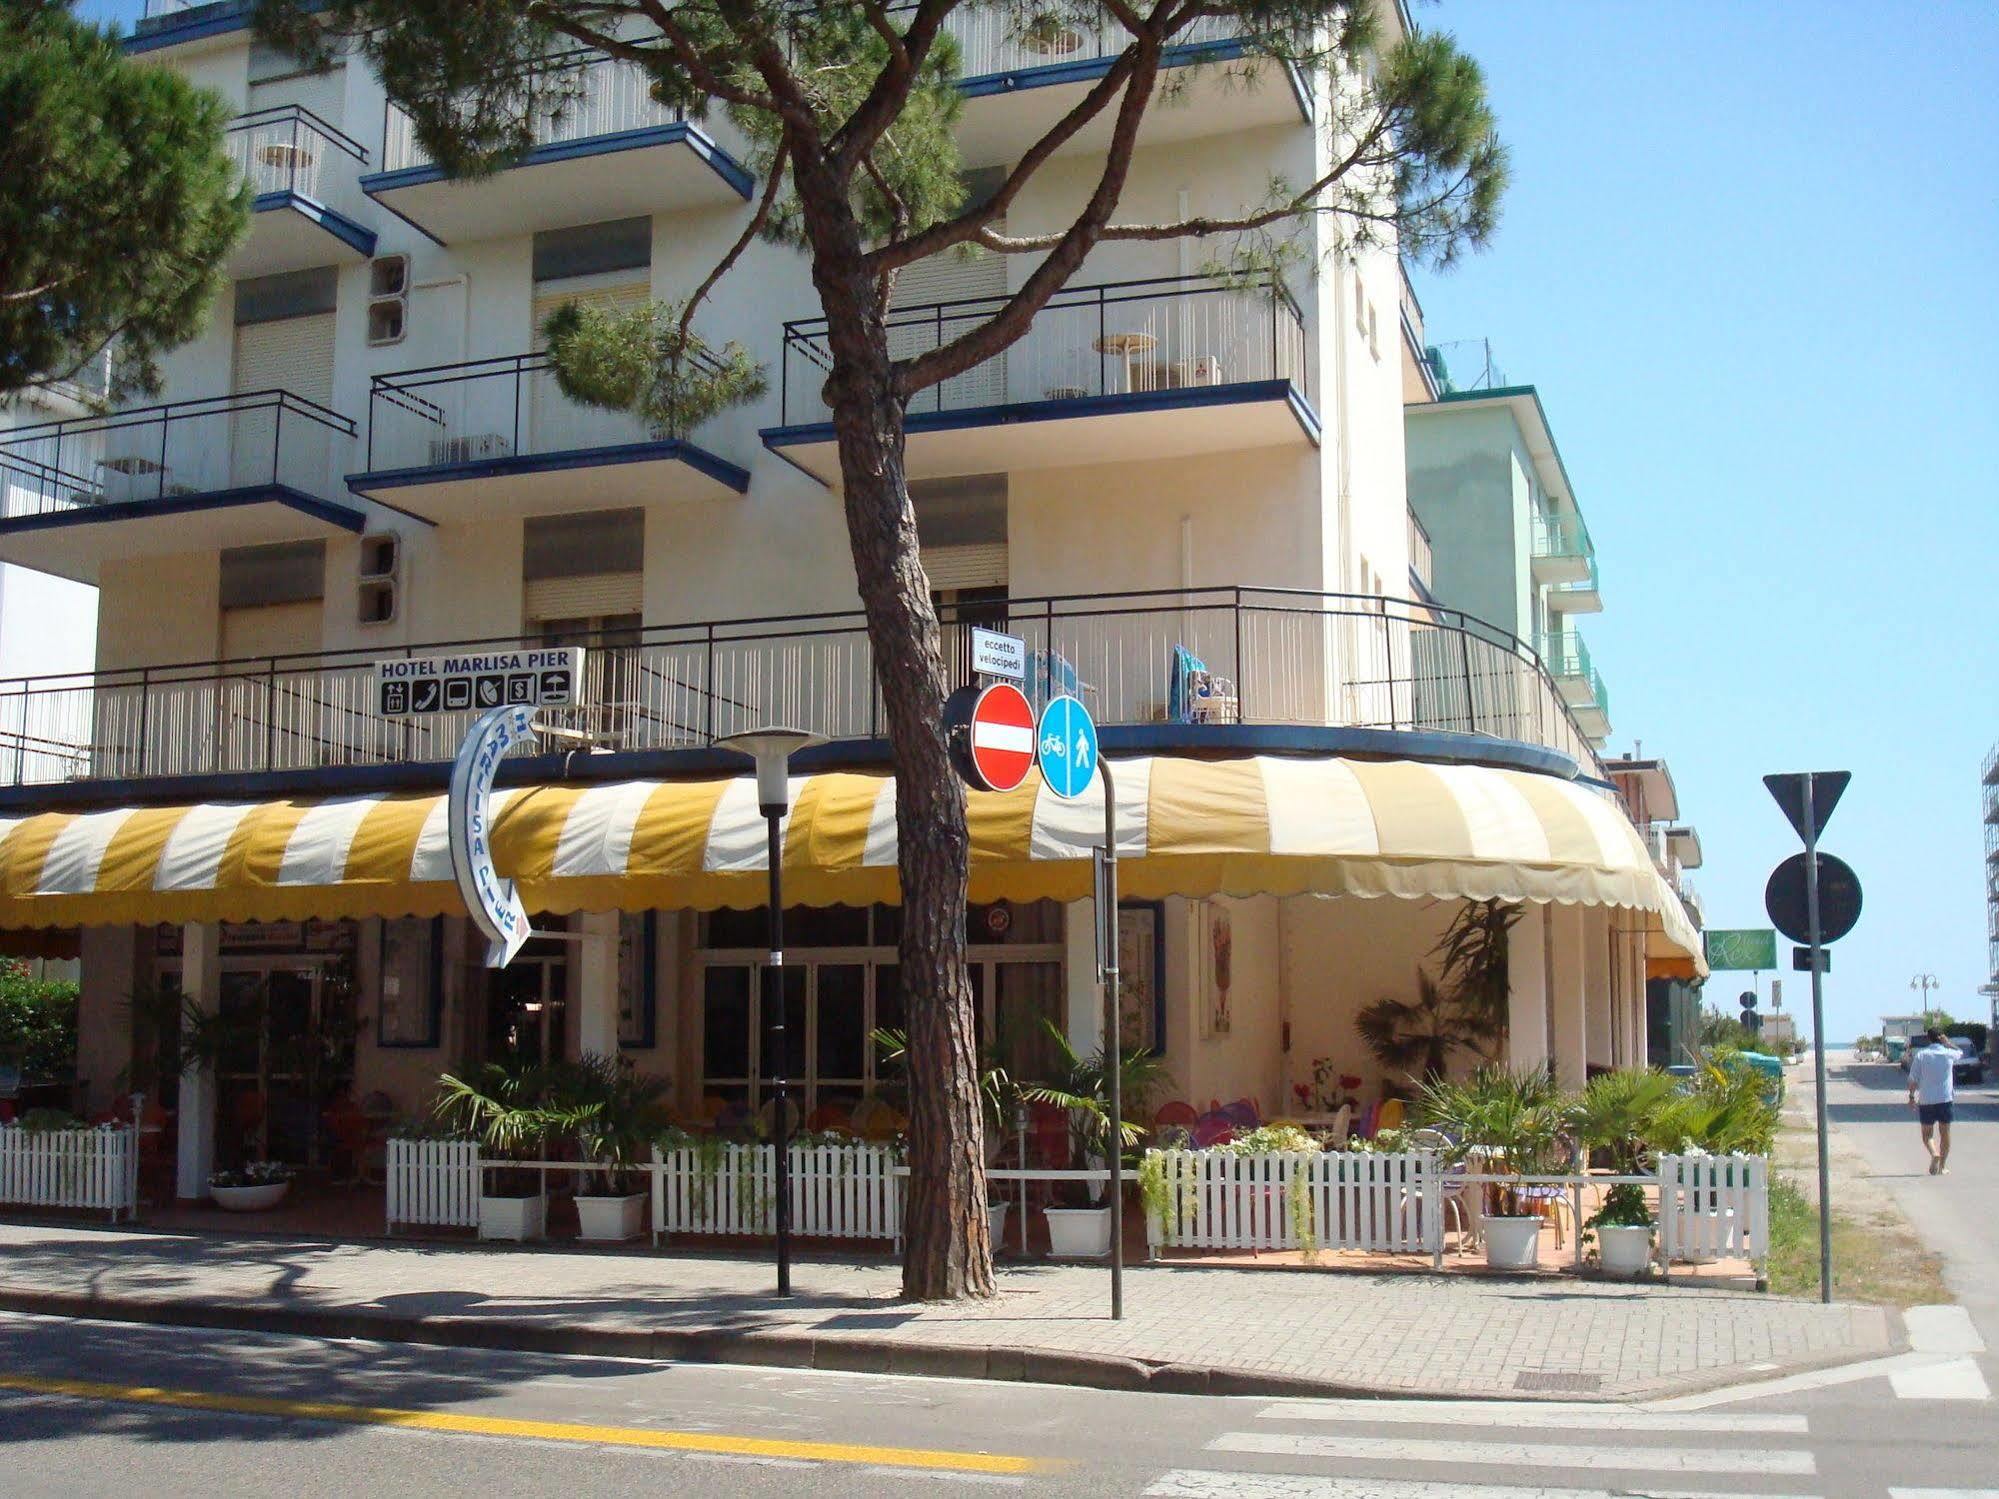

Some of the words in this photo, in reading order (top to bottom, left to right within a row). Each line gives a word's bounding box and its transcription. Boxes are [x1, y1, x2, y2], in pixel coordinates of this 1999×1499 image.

[984, 640, 1016, 654] eccetto
[382, 661, 437, 678] HOTEL
[443, 655, 521, 673] MARLISA
[528, 652, 569, 668] PIER
[979, 653, 1021, 671] velocipedi
[472, 723, 510, 856] MARLISA
[478, 866, 516, 932] PIER
